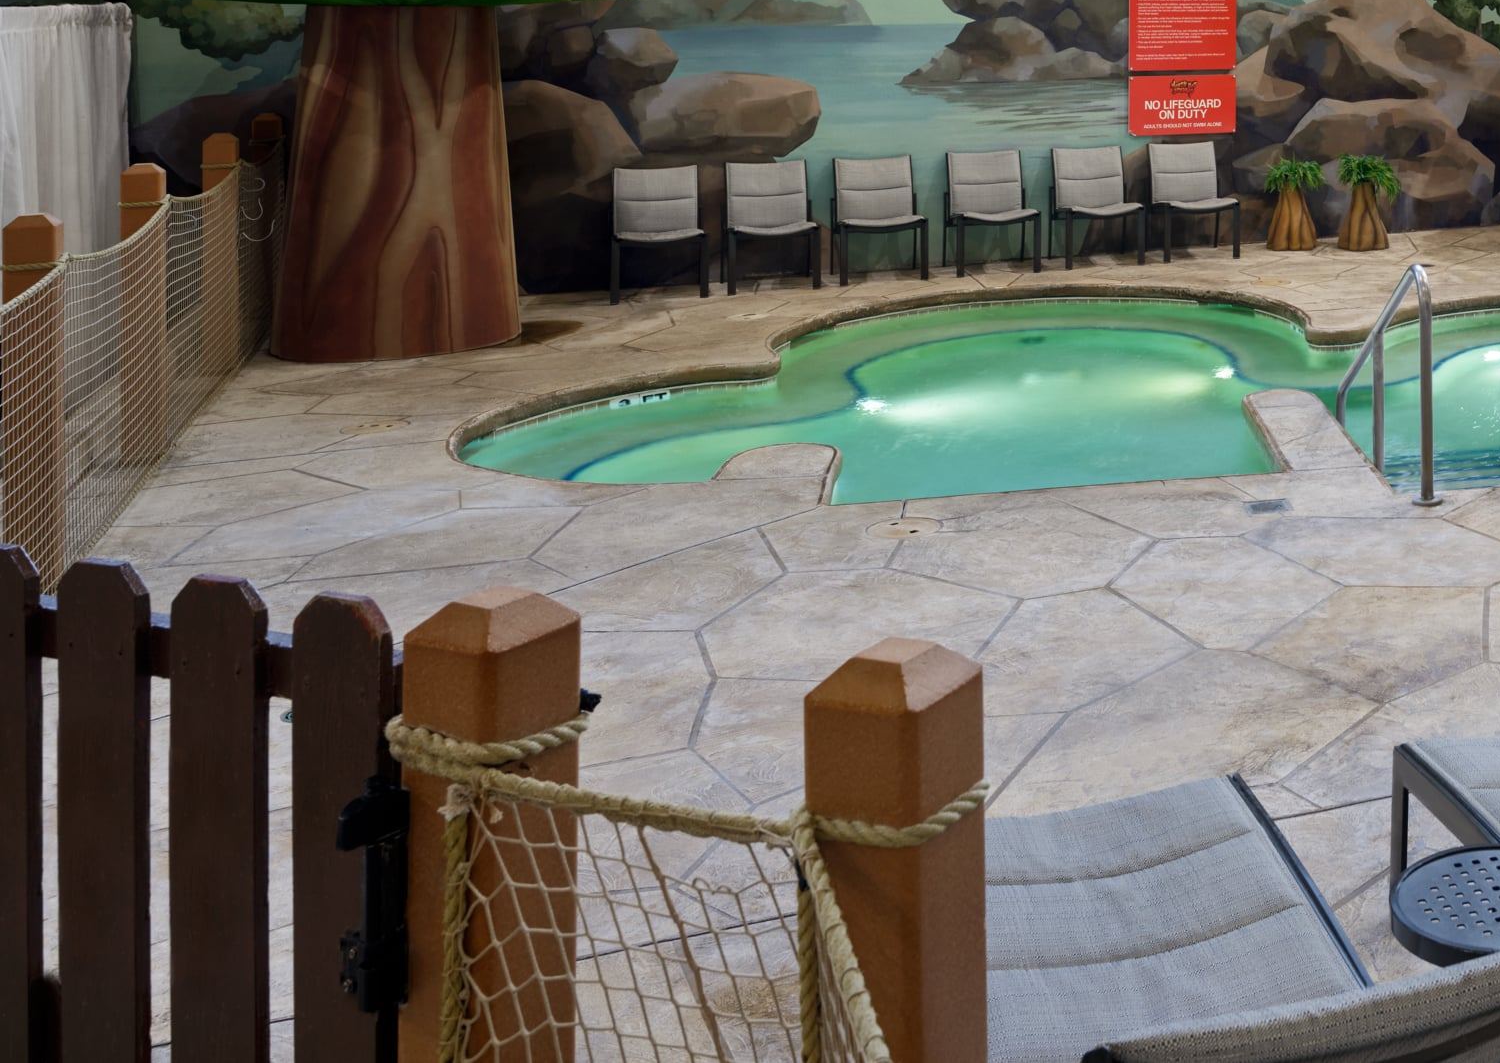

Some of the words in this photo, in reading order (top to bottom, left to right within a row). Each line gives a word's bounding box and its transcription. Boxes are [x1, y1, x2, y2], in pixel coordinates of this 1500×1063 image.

[1144, 100, 1161, 110] NO
[1163, 99, 1221, 109] LIFEGUARD
[1158, 110, 1175, 120] ON
[1177, 109, 1207, 119] DUTY
